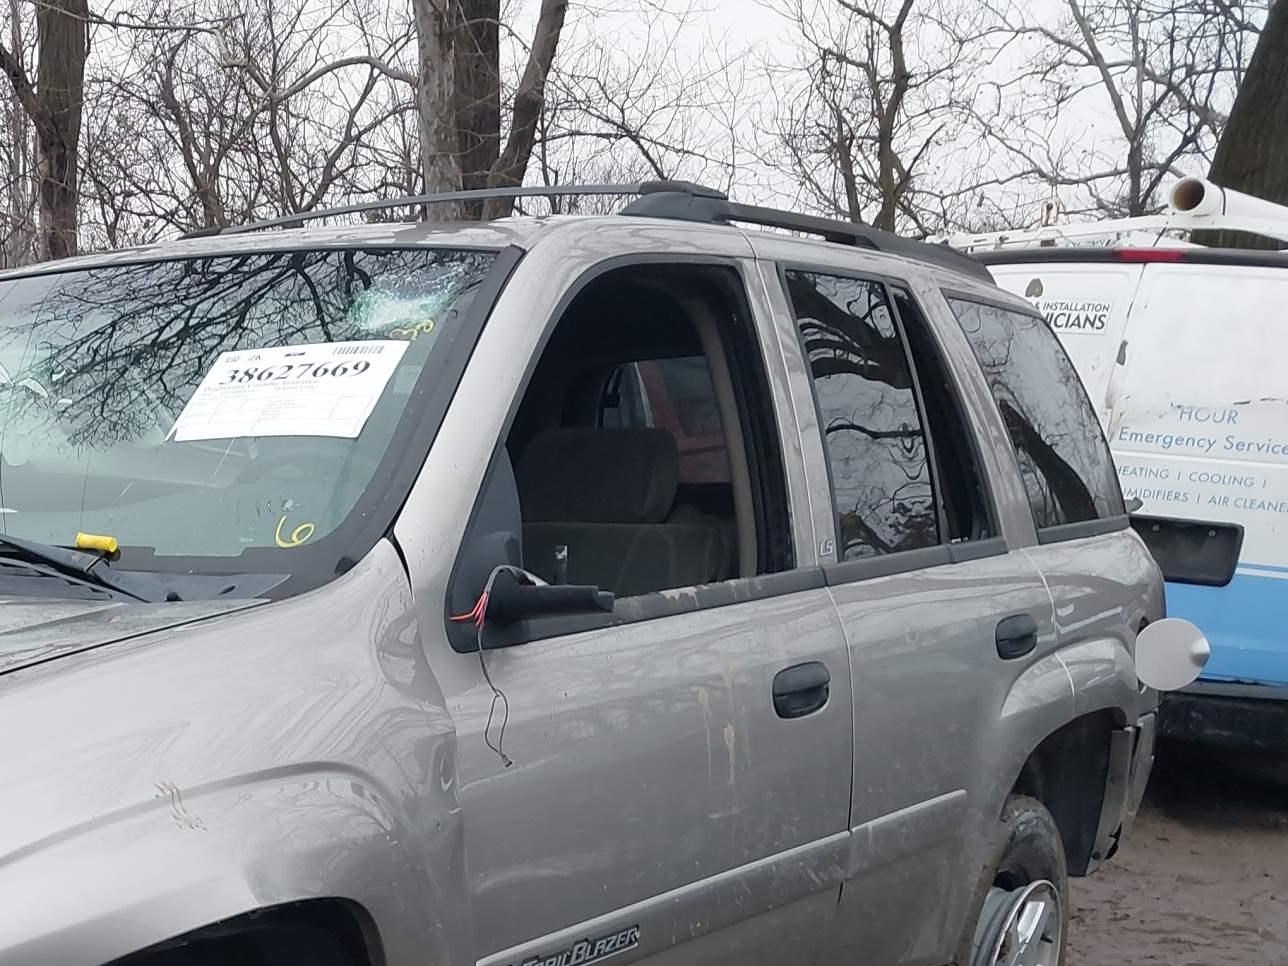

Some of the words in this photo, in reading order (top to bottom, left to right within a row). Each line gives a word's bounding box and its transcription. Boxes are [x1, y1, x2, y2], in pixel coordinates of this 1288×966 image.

[1043, 301, 1110, 313] INSTALLATION
[218, 359, 372, 386] 38627669
[1179, 405, 1239, 425] HOUR
[1118, 426, 1217, 453] Emergency
[1188, 471, 1256, 488] COOLING
[1123, 486, 1189, 503] MIDIFIERS
[1208, 495, 1230, 507] AIR
[1234, 497, 1288, 513] CLEANE
[819, 540, 833, 557] LS
